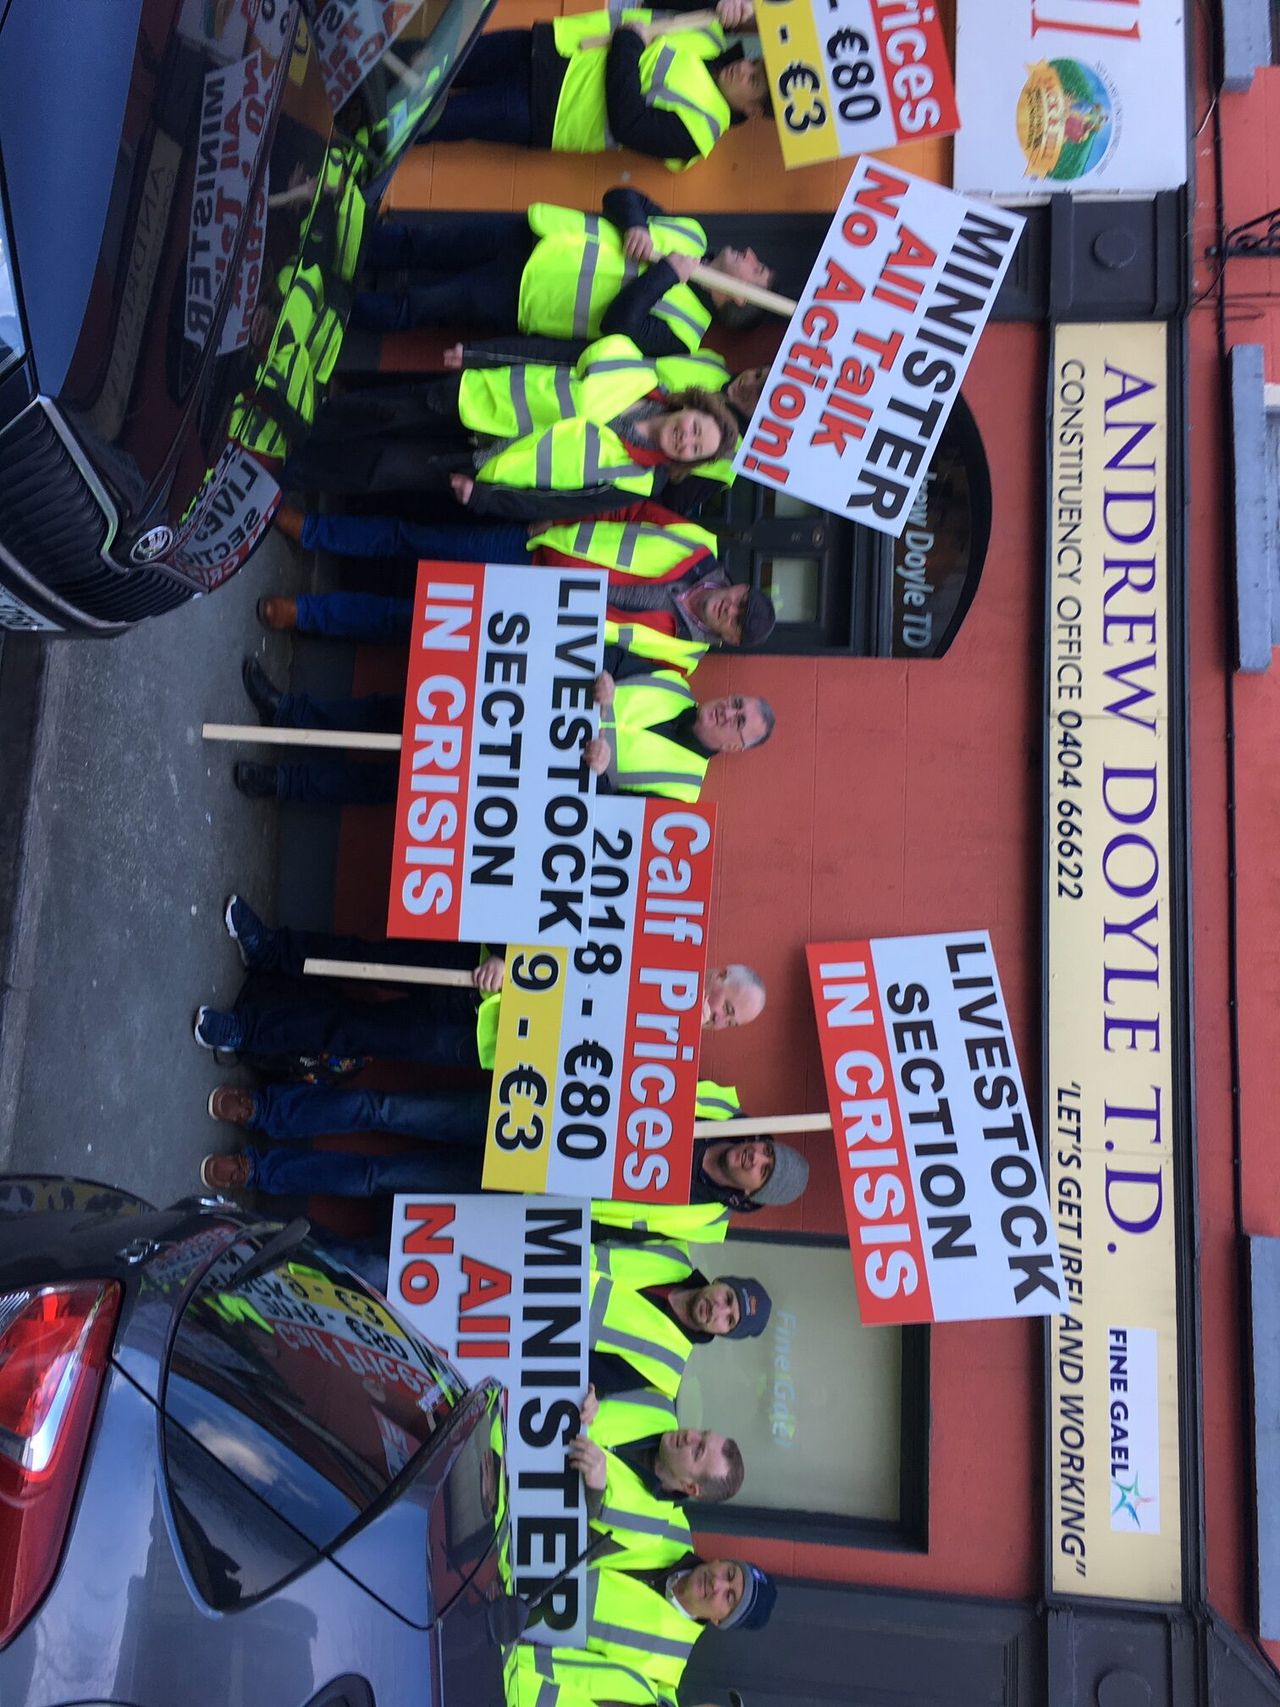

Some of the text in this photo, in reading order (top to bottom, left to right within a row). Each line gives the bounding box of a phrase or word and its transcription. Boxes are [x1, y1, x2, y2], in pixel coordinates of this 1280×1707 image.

[779, 63, 827, 133] €3
[826, 27, 882, 122] €80
[877, 0, 941, 134] rices
[742, 167, 910, 488] No Action!
[810, 226, 938, 458] All Talk
[846, 212, 1015, 520] MINISTER
[895, 529, 935, 607] Doyle
[902, 612, 932, 649] TD
[1056, 359, 1085, 899] CONSTITUENCY OFFICE 0404 66622
[401, 582, 475, 916] IN CRISIS
[470, 611, 530, 887] SECTION
[538, 579, 601, 934] LIVESTOCK
[1102, 358, 1163, 1254] ANDREW DOYLE T.D.
[495, 1064, 548, 1152] €3
[518, 1017, 530, 1038] -
[556, 829, 633, 1160] 2018 - €80
[622, 811, 711, 1192] Calf Prices
[819, 961, 919, 1300] IN CRISIS
[886, 982, 977, 1260] SECTION
[946, 942, 1061, 1305] LIVESTOCK
[401, 1203, 457, 1305] No
[457, 1255, 512, 1359] All
[1057, 1177, 1082, 1238] GET
[515, 1208, 583, 1633] MINISTER
[1109, 1329, 1130, 1478] FINE GAEL
